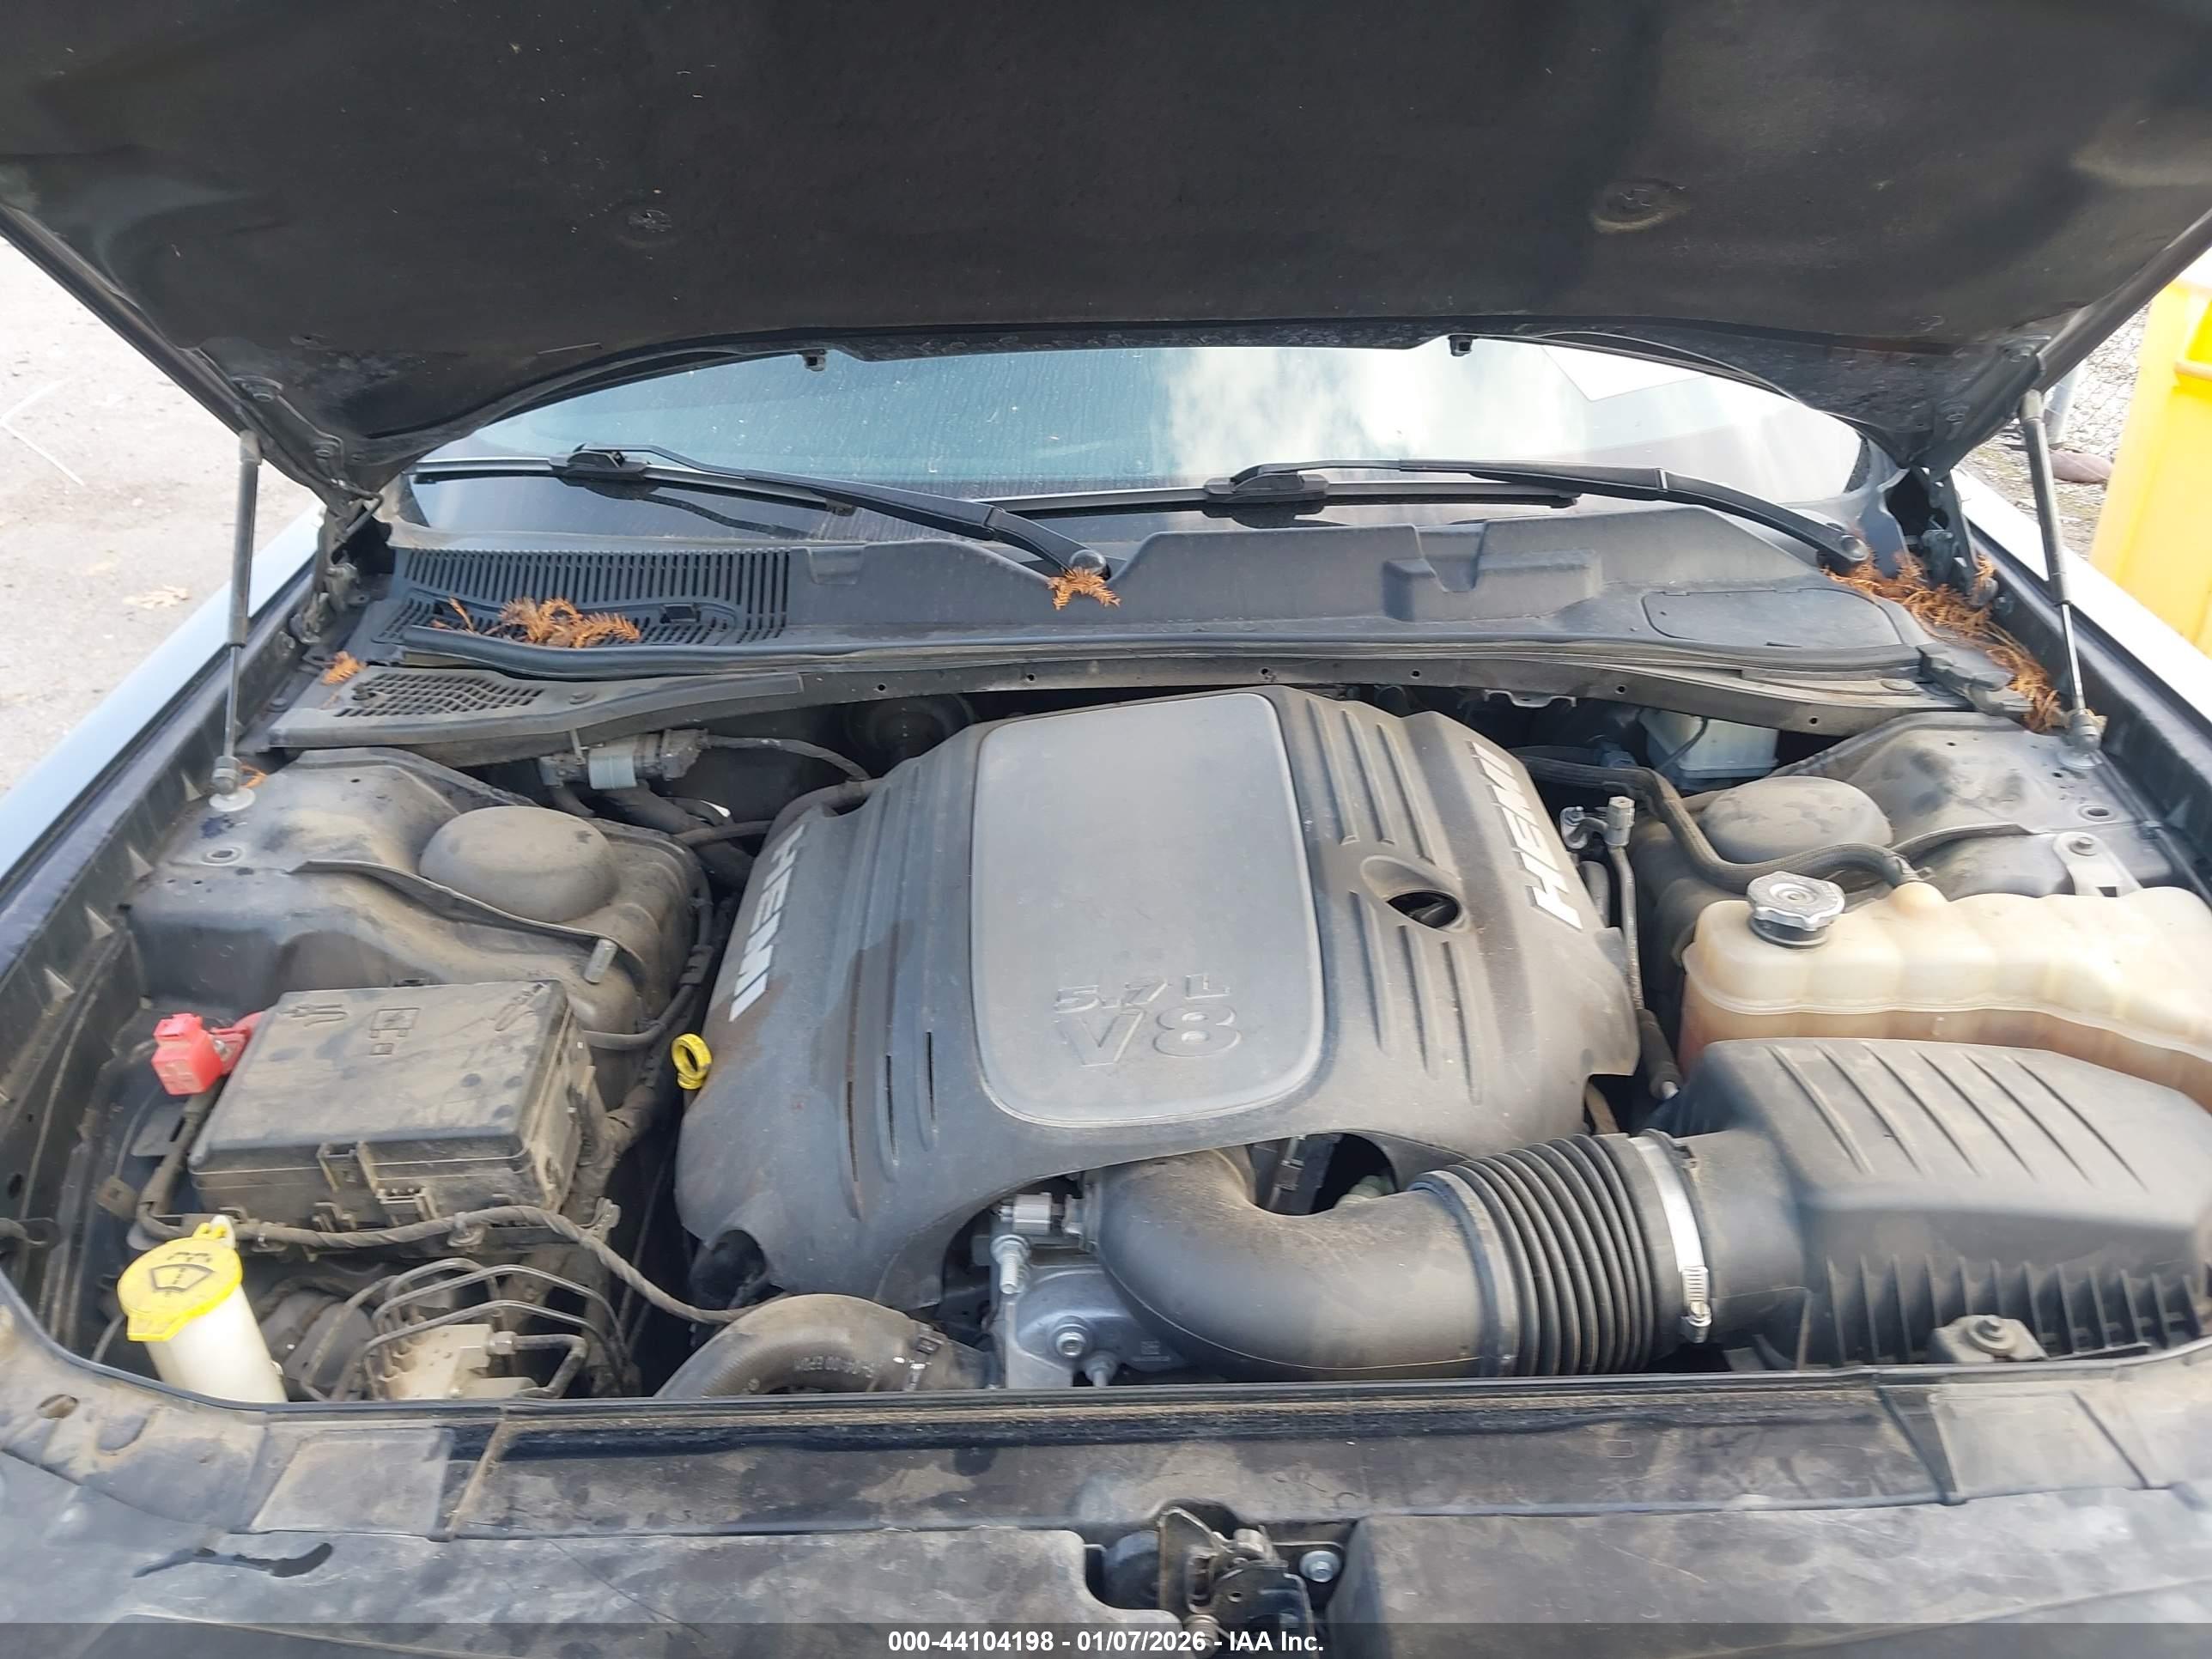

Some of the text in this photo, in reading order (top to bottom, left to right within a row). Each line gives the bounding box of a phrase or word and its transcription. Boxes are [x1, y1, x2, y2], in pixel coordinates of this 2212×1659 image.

[728, 823, 806, 1022] HEMI
[1468, 740, 1583, 931] HEMI
[1054, 1003, 1243, 1067] V8
